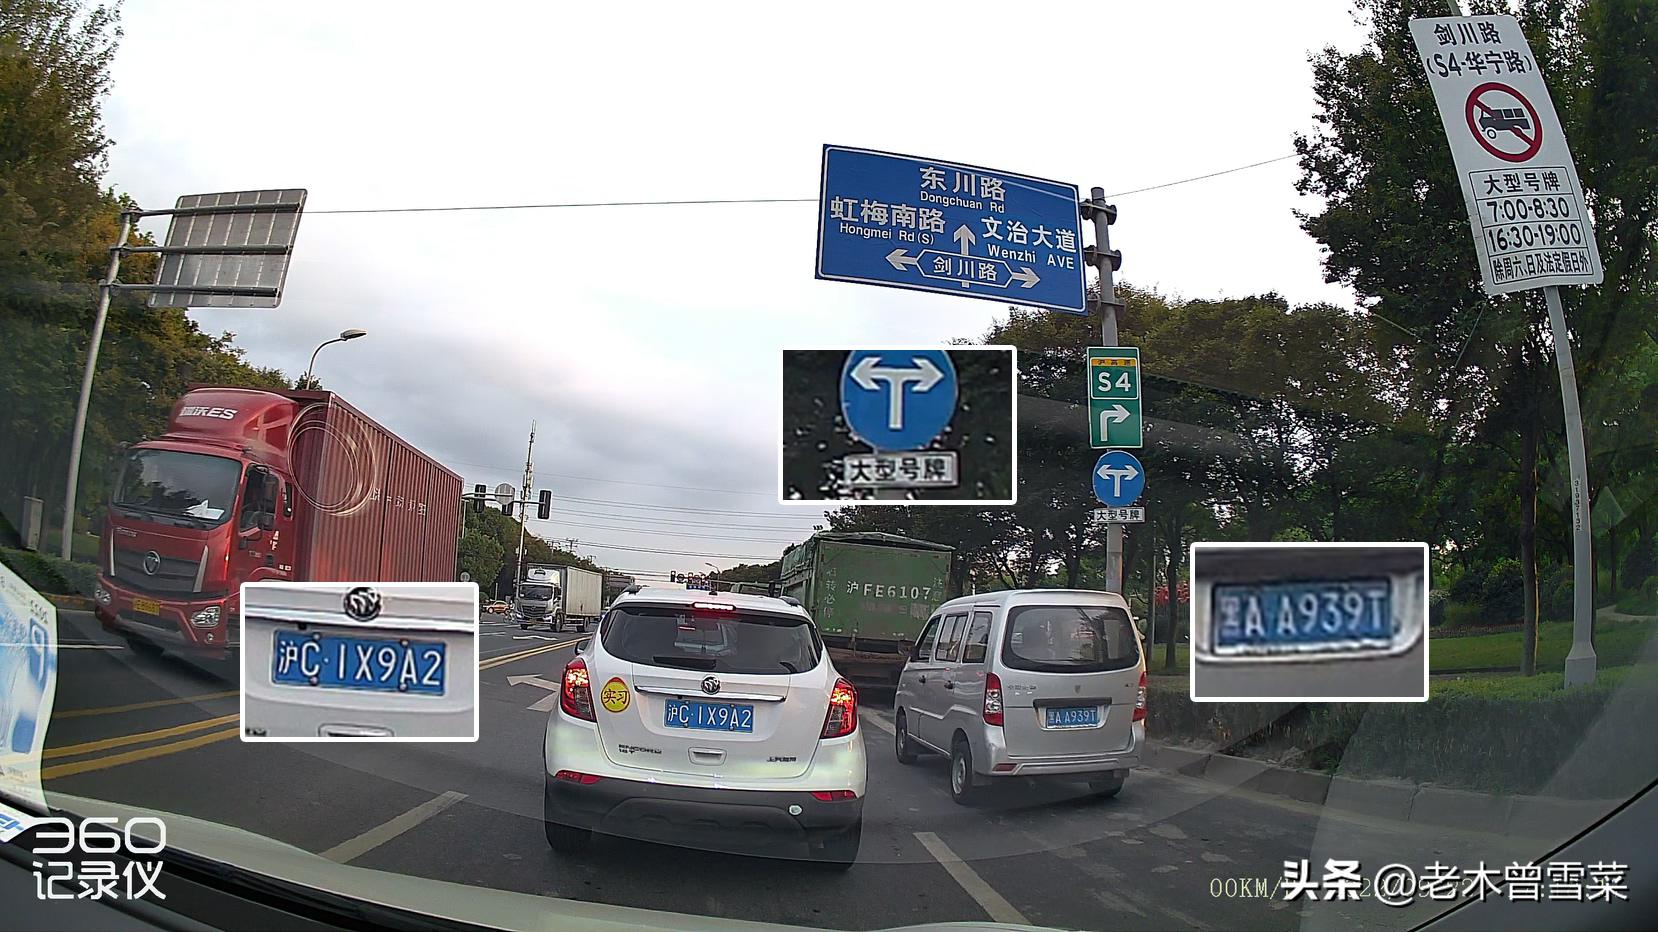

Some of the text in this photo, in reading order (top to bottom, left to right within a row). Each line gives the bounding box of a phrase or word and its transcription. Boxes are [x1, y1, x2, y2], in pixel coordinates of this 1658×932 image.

[1434, 21, 1502, 46] 剑川路
[1426, 51, 1533, 78] (S4-华宁路)
[919, 166, 1006, 202] 东川路
[1484, 171, 1561, 196] 大型号牌
[830, 195, 946, 234] 虹梅南路
[920, 190, 1005, 214] Dongchuan Rd
[1486, 197, 1570, 223] 7:00-8:30
[839, 222, 892, 241] Hongmei
[981, 216, 1077, 253] 文治大道
[1488, 223, 1582, 251] 16:30-19:00
[933, 255, 997, 282] 剑川路
[987, 244, 1075, 270] Wenzhi AVE
[1098, 371, 1132, 392] S4
[851, 458, 946, 482] 大型号牌
[1095, 508, 1141, 521] 大型号牌
[846, 580, 932, 600] 沪FE6107
[603, 688, 628, 705] 实习
